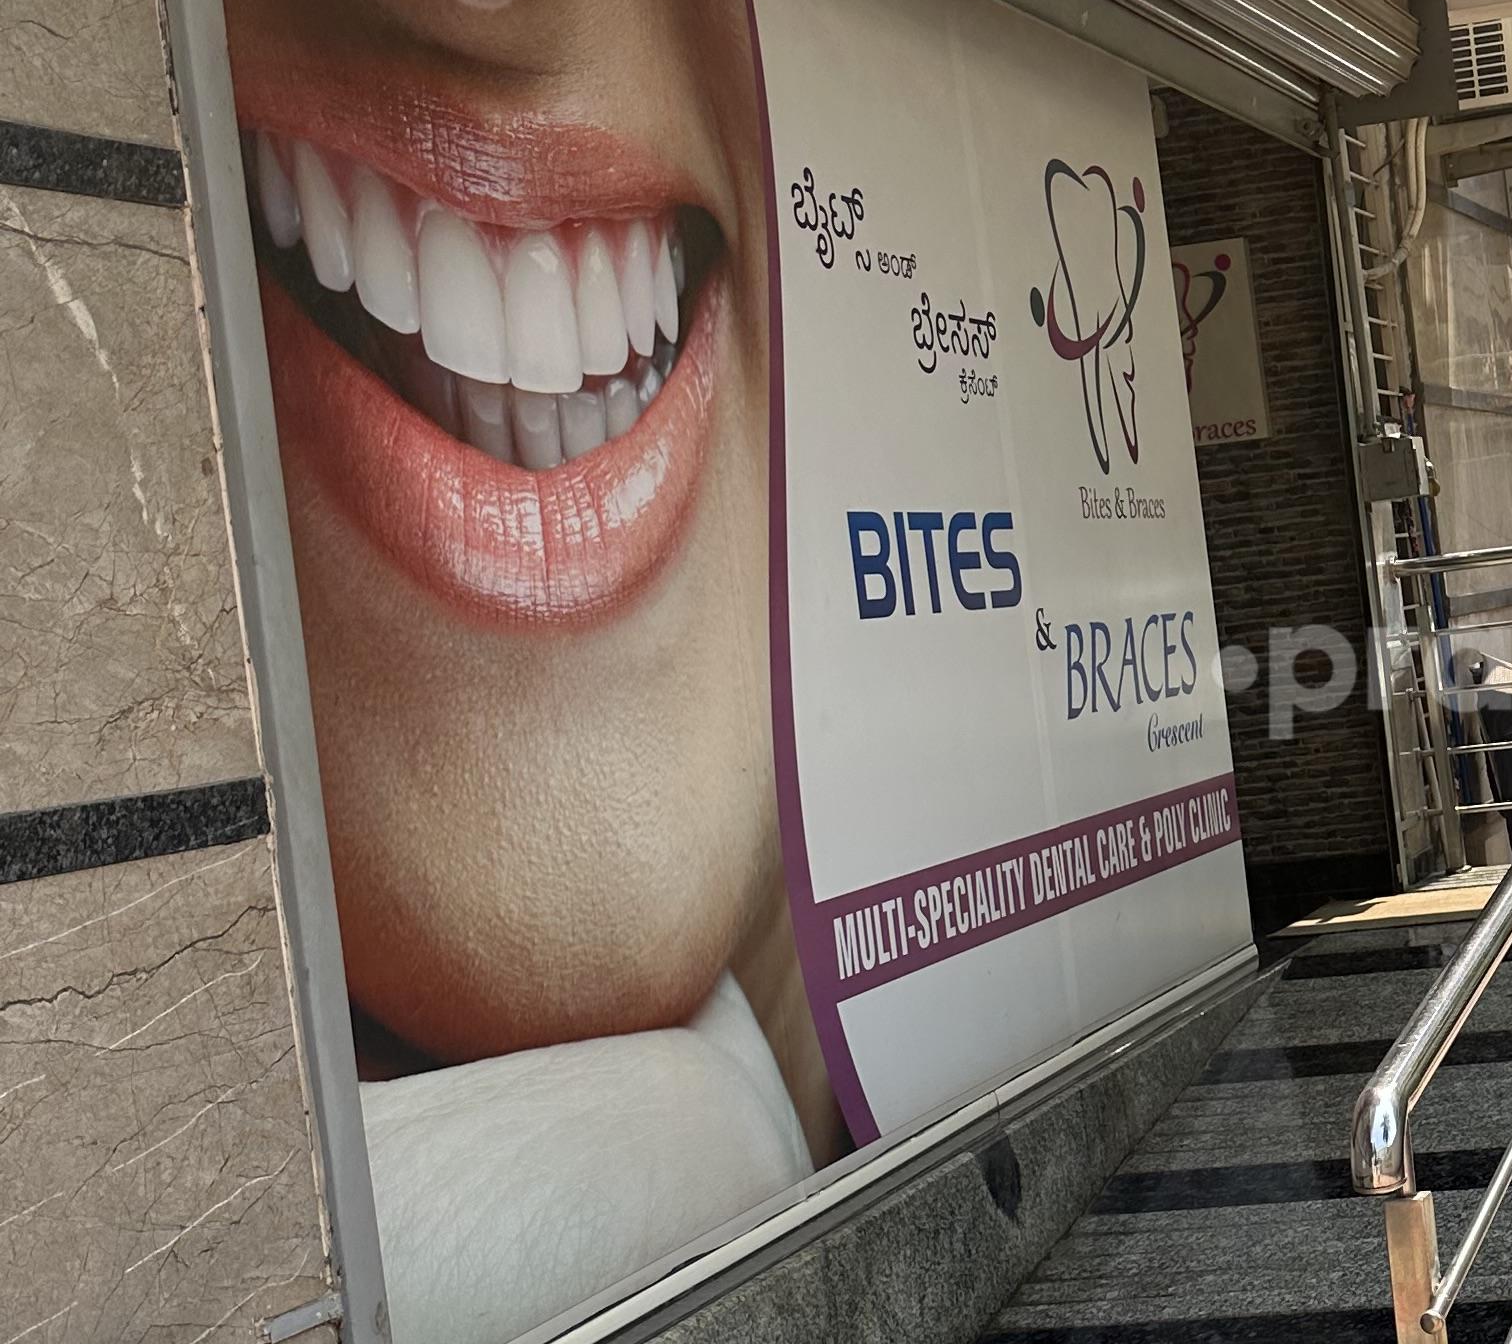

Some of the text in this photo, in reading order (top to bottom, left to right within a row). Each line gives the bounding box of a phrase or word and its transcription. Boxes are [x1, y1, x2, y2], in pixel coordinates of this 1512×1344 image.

[910, 291, 997, 374] ಬ್ರೇಸಸ್
[1193, 418, 1257, 442] races
[1078, 486, 1166, 520] Bites & Braces
[846, 510, 1023, 620] BITES
[1035, 607, 1057, 651] &
[1065, 610, 1198, 720] BRACES
[1147, 711, 1204, 753] Crescent
[833, 788, 1231, 980] MULTI-SPECIALITY DENTAL CARE & POLY CLINIC
